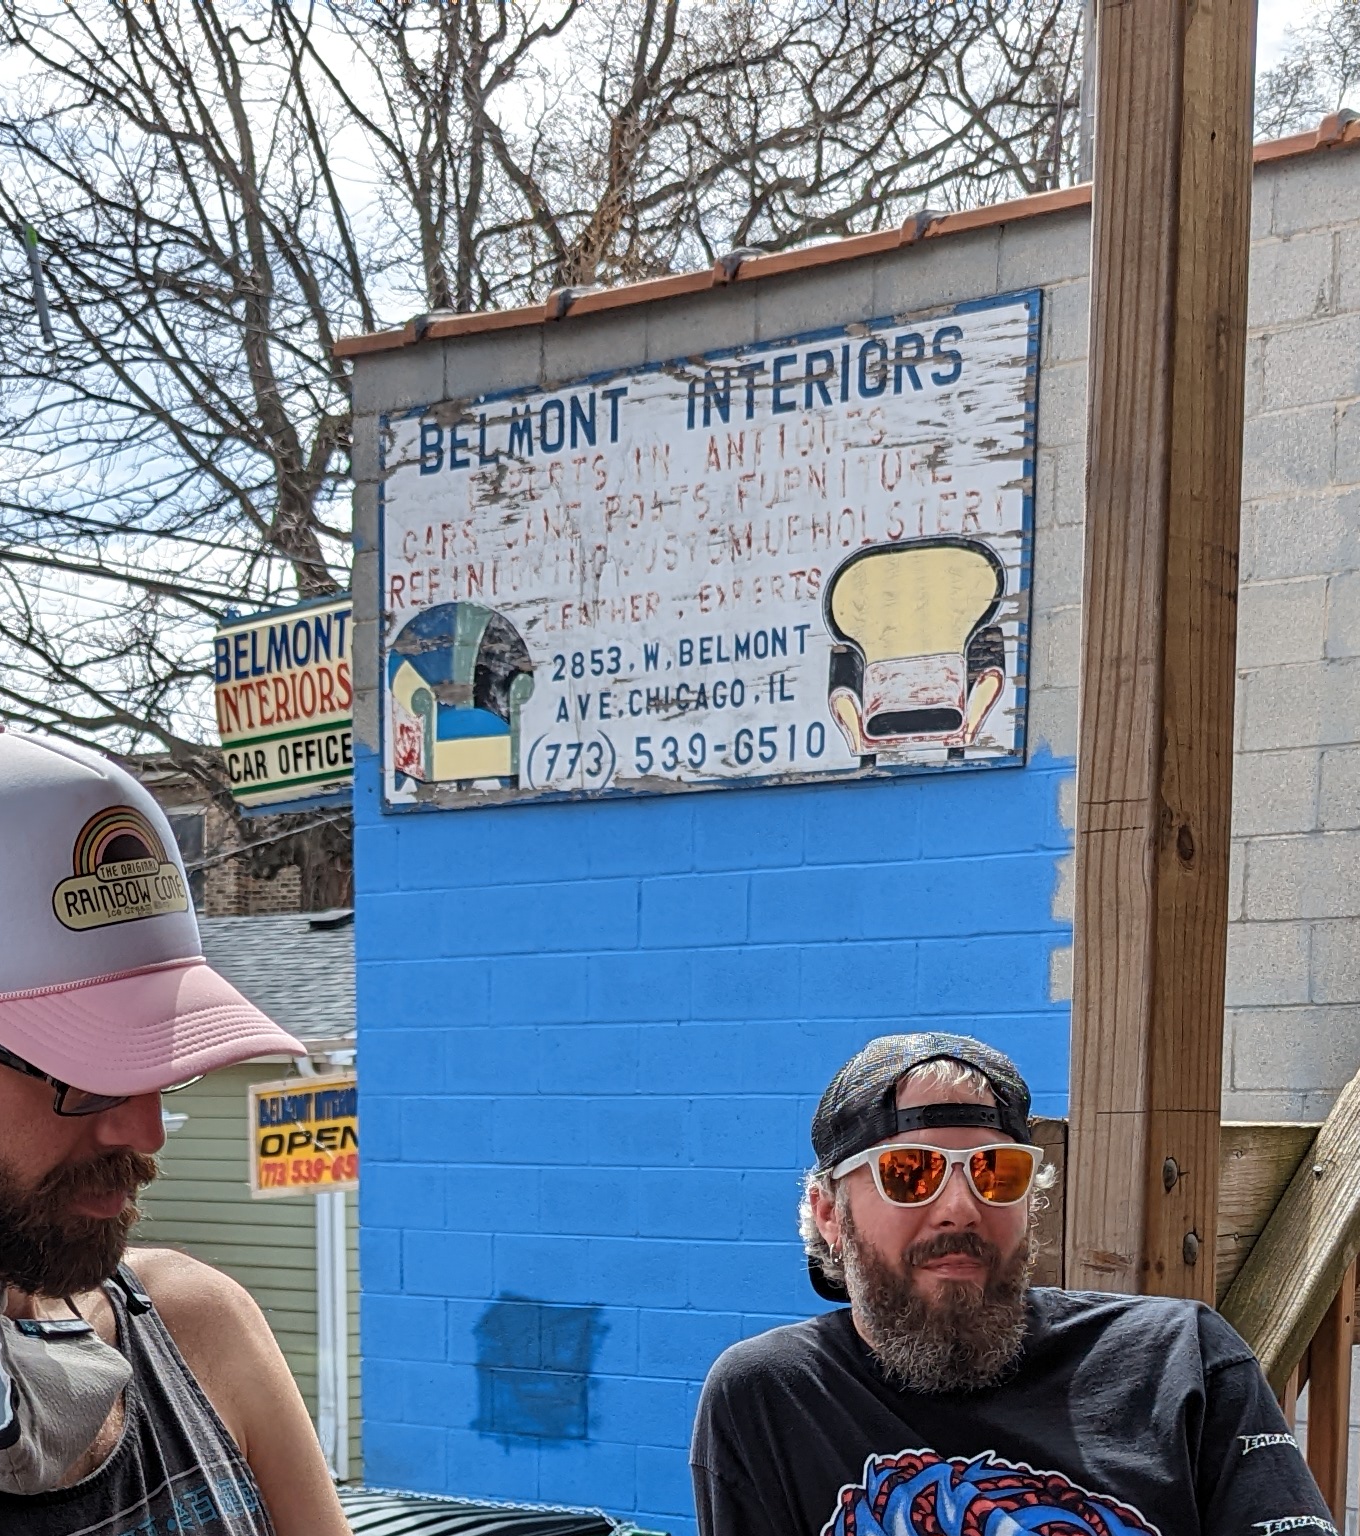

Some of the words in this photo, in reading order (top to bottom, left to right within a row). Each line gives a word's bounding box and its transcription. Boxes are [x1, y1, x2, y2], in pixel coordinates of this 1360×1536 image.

[420, 387, 628, 476] BELMONT
[687, 325, 964, 431] INTERIORS
[215, 609, 353, 685] BELMONT
[678, 624, 811, 668] BELMONT
[215, 663, 353, 734] INTERIORS
[768, 674, 795, 705] IL
[228, 749, 269, 784] CAR
[278, 733, 353, 776] OFFICE
[527, 729, 617, 791] (773)
[634, 721, 826, 775] 539-6510
[100, 865, 119, 879] THE
[64, 878, 152, 917] RAINBOW
[154, 875, 185, 901] CONE
[260, 1126, 358, 1157] OPEN
